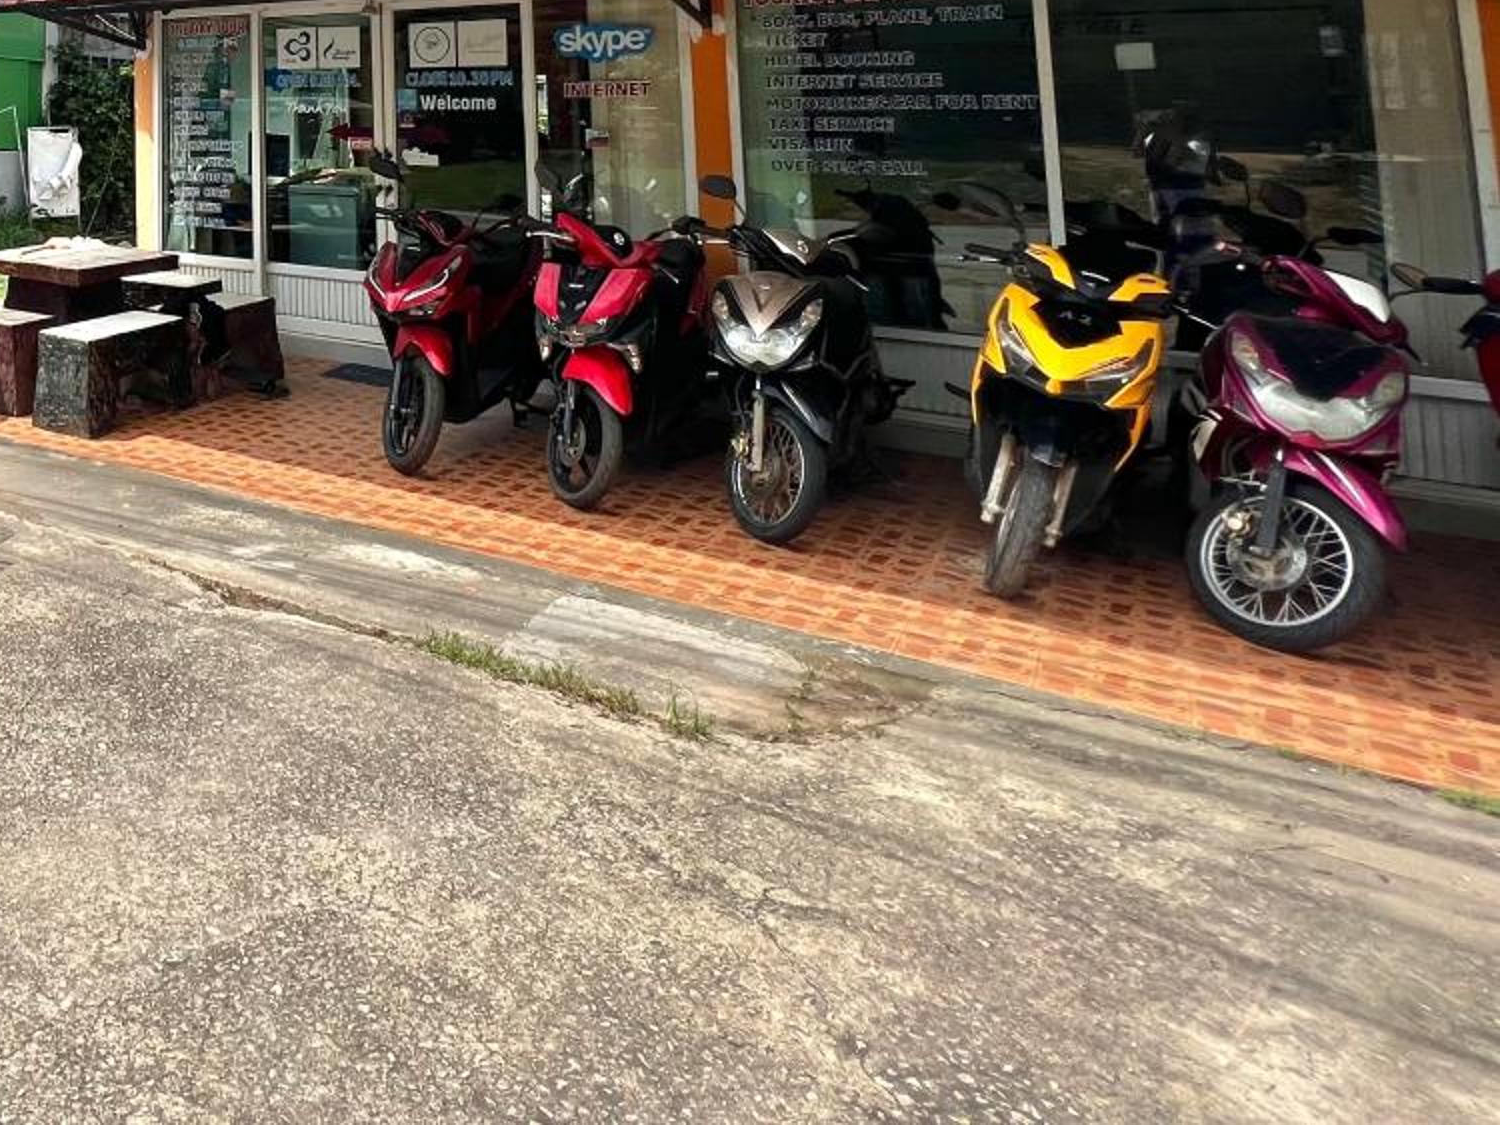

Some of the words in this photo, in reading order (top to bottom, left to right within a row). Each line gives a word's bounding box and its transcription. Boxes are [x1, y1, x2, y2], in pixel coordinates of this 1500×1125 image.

[559, 25, 646, 58] skype
[563, 80, 651, 98] INTERNET
[765, 74, 857, 90] INTERNET
[858, 72, 945, 89] SERVICE
[419, 93, 498, 111] Welcome
[935, 94, 979, 110] FOR
[981, 93, 1039, 110] RENT
